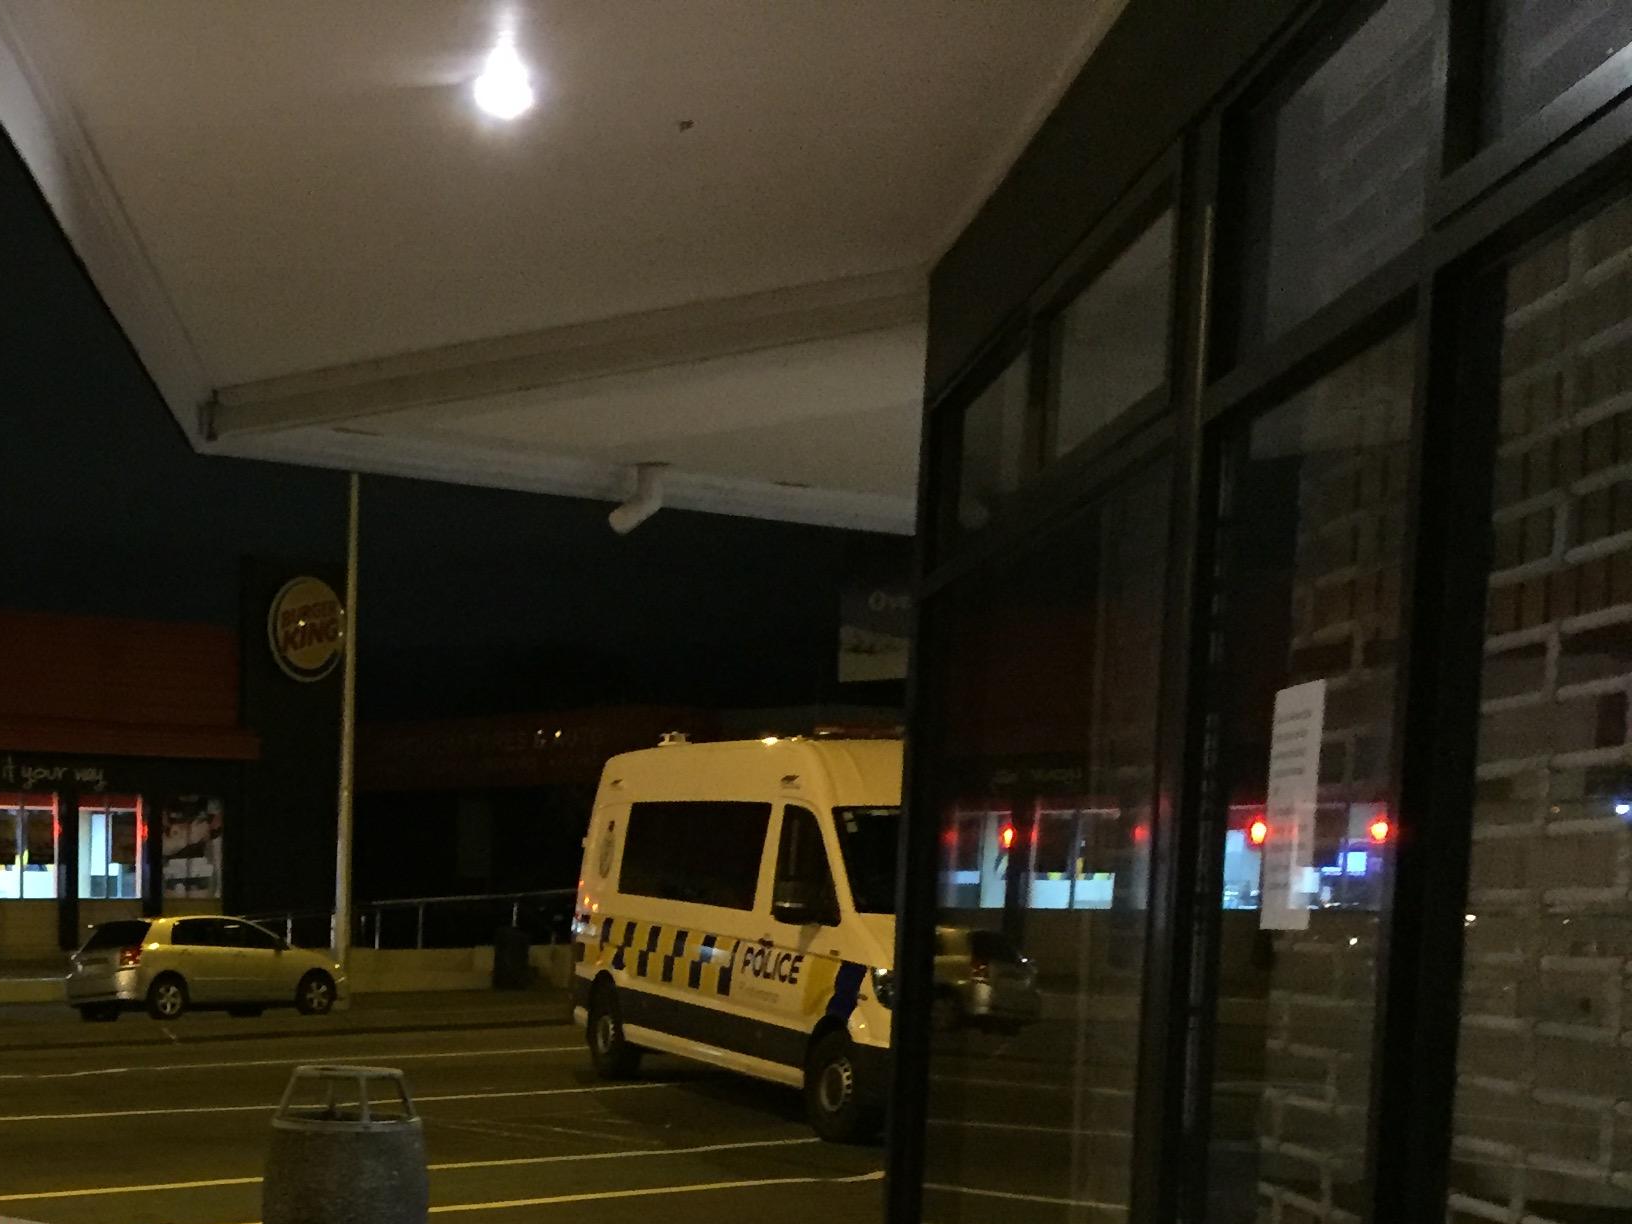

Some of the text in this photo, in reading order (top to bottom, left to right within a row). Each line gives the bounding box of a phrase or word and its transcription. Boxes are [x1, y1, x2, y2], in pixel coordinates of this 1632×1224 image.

[281, 600, 337, 628] BURGER
[283, 617, 338, 651] KING
[2, 753, 17, 783] it
[21, 765, 68, 790] your
[741, 946, 805, 984] POLICE
